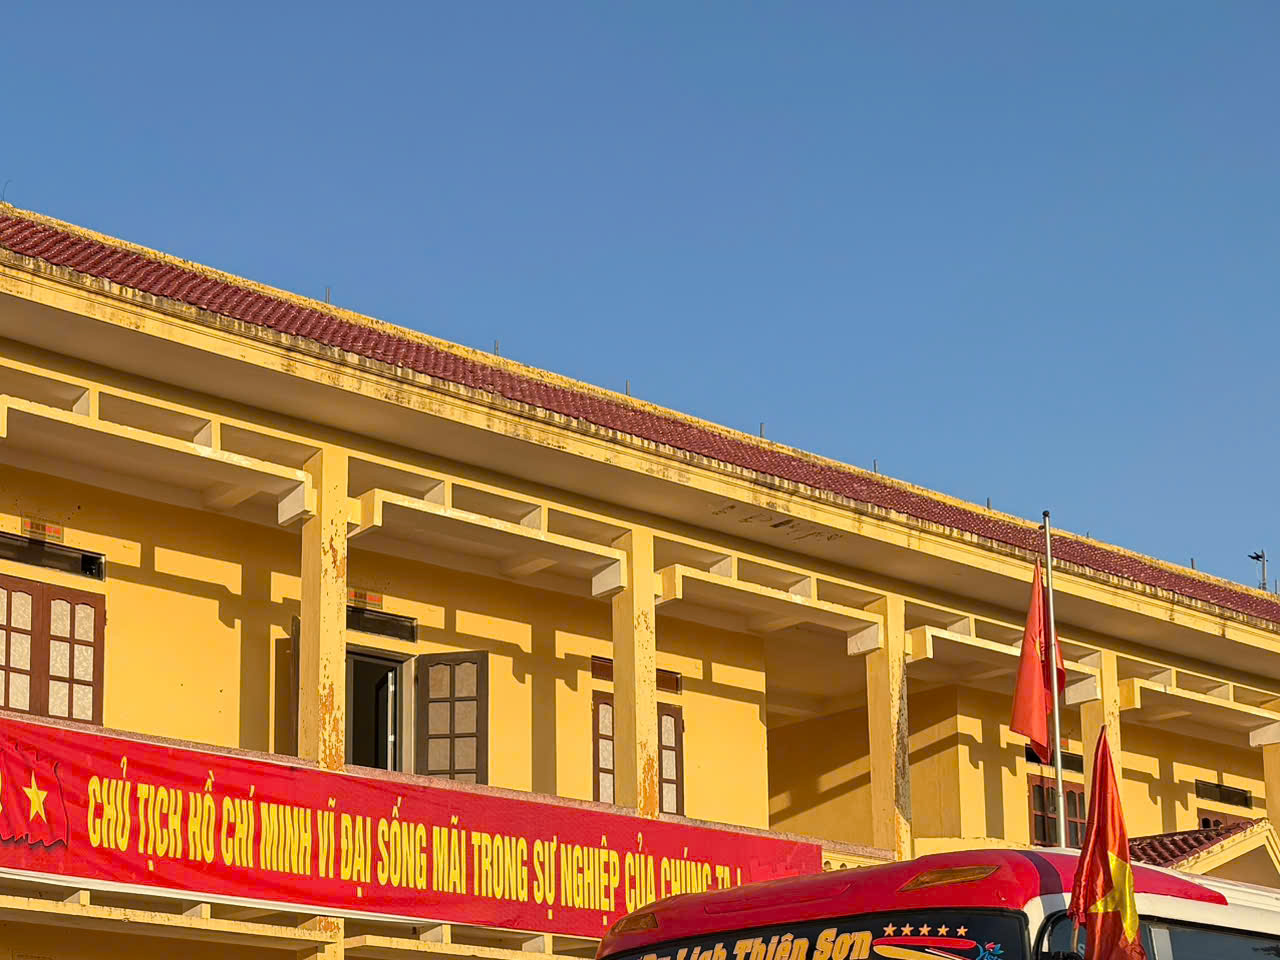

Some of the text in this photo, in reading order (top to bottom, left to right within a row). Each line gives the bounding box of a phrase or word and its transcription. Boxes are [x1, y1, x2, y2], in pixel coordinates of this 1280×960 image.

[88, 756, 131, 852] CHỦ
[137, 783, 183, 871] TỊCH
[189, 770, 216, 863] HỒ
[222, 784, 255, 868] CHÍ
[260, 803, 312, 876] MINH
[317, 797, 336, 878] VĨ
[339, 813, 372, 897] ĐẠI
[377, 796, 427, 889] SỐNG
[432, 815, 467, 895] MÃI
[472, 831, 529, 902] TRONG
[533, 835, 558, 919] SỰ
[560, 833, 620, 925] NGHIỆP
[625, 831, 657, 914] CỦA
